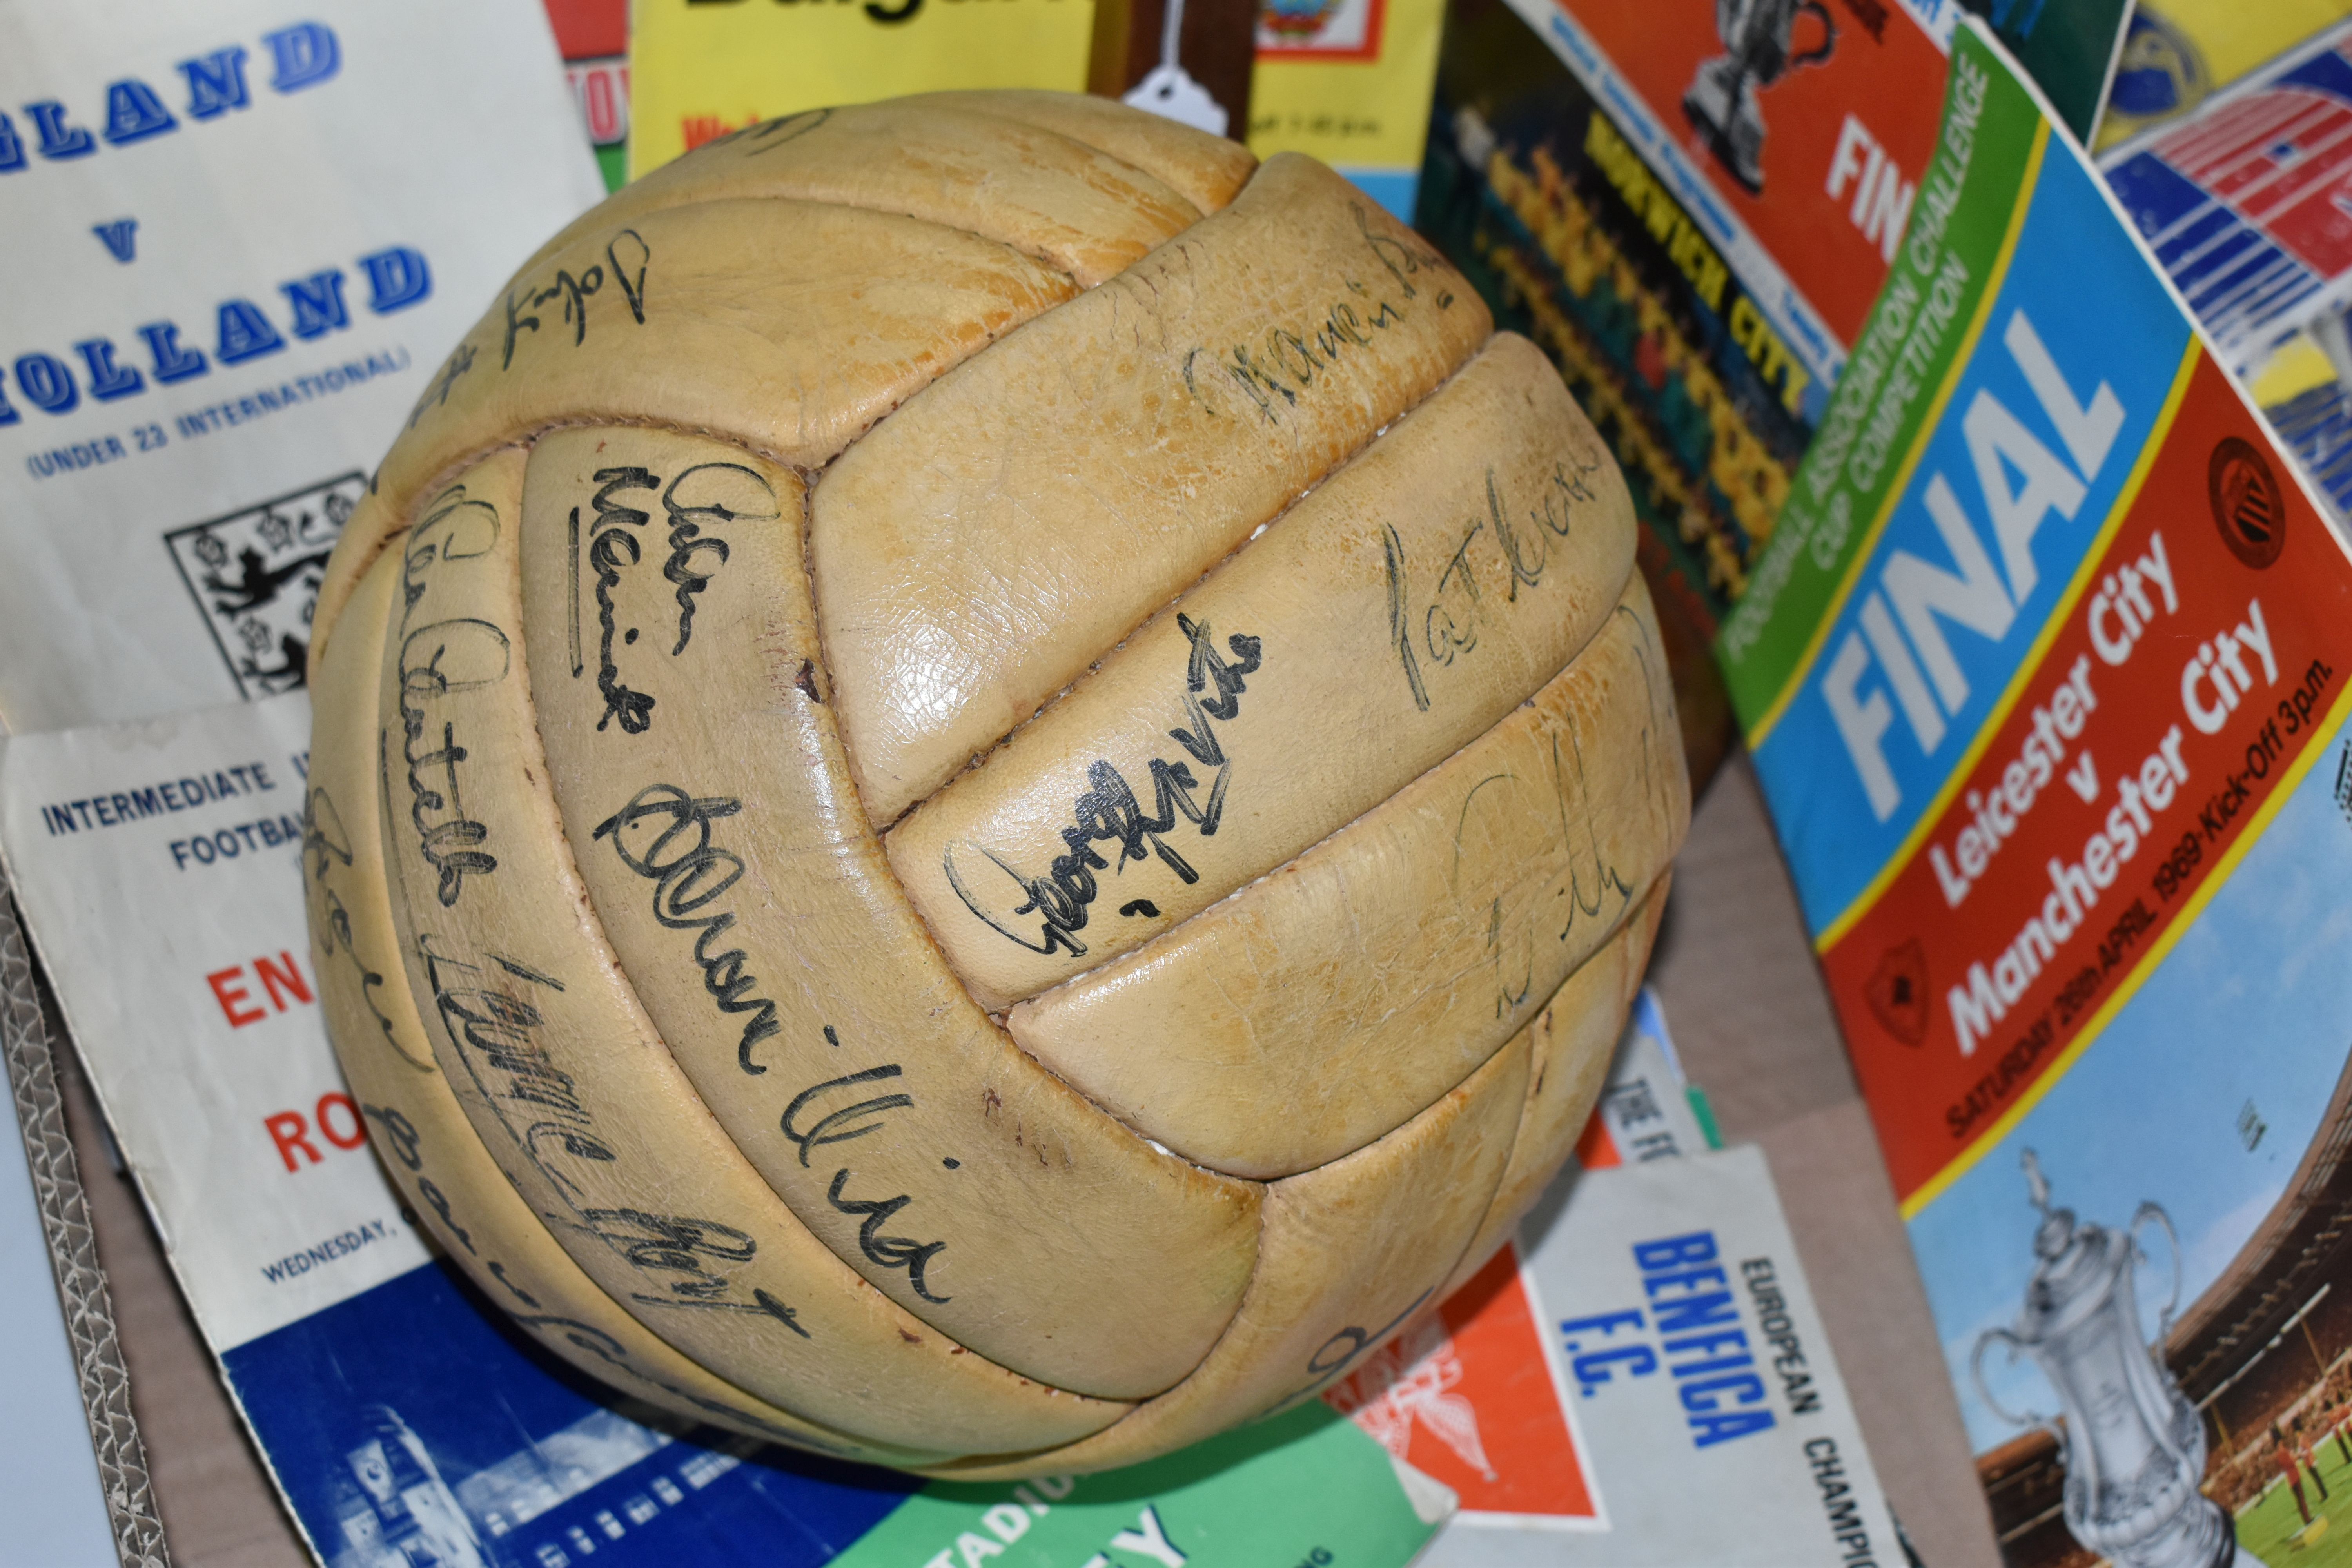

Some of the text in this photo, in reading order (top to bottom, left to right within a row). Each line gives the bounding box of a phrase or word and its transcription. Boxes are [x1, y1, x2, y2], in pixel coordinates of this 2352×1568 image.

[1730, 296, 1808, 414] CITY
[1806, 269, 1920, 506] ASSOCIATION
[1910, 51, 1989, 276] CHALLENGE
[26, 434, 127, 481] (UNDER
[133, 423, 169, 453] 23
[176, 345, 411, 439] INTERNATIONAL)
[1810, 249, 1970, 572] CUP COMPETITION
[1821, 307, 2127, 822] FINAL
[41, 761, 275, 837] INTERMEDIATE
[1929, 529, 2178, 908] Leicester City
[2066, 749, 2099, 804] v
[1945, 1013, 2055, 1139] SATURDAY
[2054, 966, 2100, 1026] 26th
[2099, 897, 2159, 976] APRIL
[2278, 659, 2333, 736] 3p.m.
[1946, 597, 2278, 1057] Manchester City
[260, 1218, 398, 1284] WEDNESDAY,
[1633, 1230, 1777, 1448] BENFICA
[1741, 1256, 1822, 1414] EUROPEAN
[1561, 1309, 1658, 1399] F.C.
